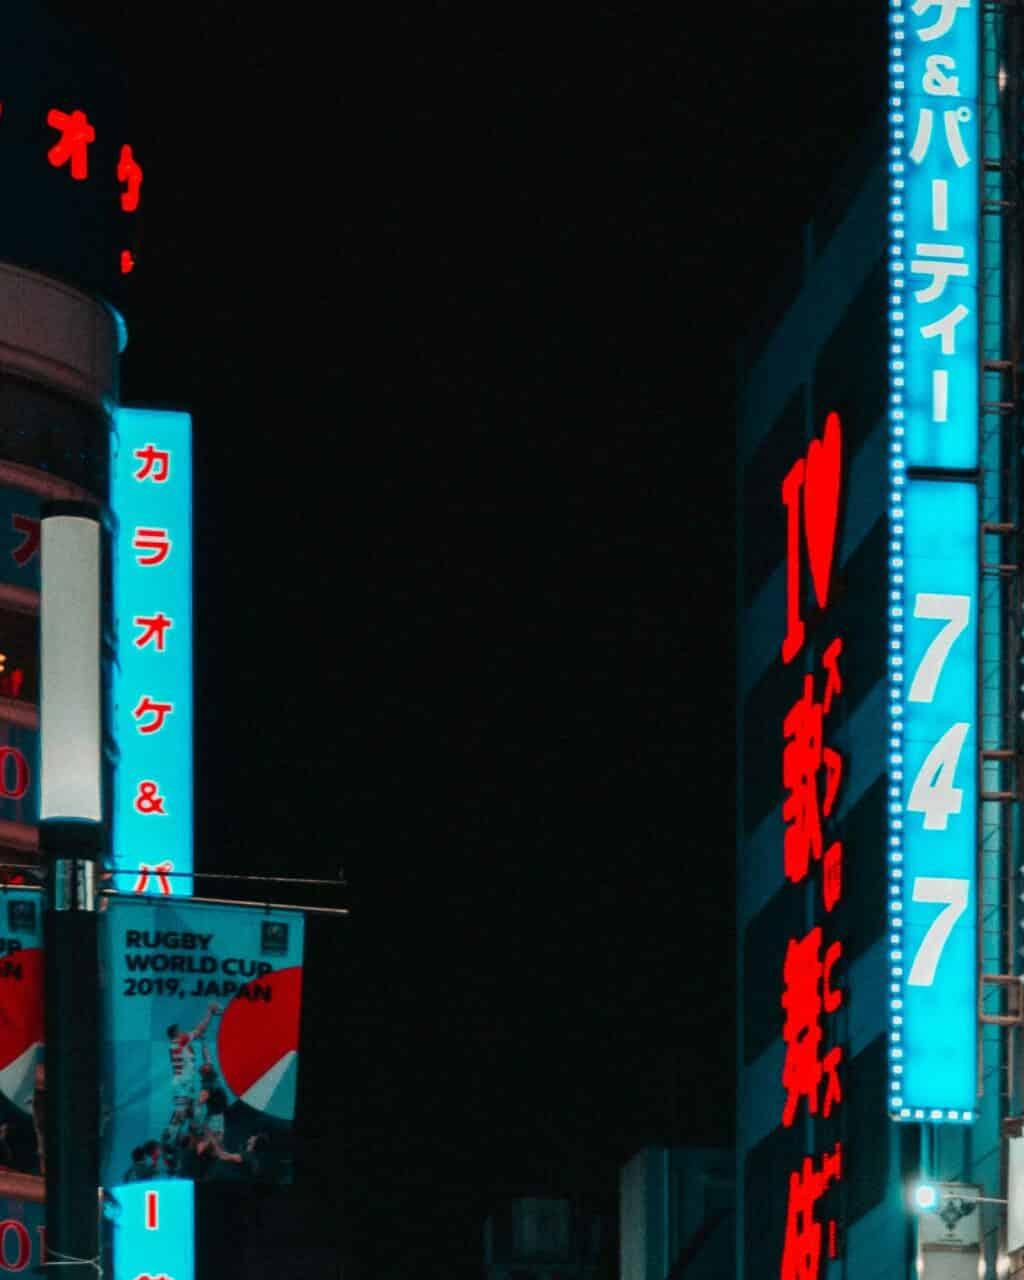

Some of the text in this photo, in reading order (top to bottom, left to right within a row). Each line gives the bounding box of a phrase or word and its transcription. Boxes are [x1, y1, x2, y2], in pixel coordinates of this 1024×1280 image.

[907, 593, 971, 987] 747
[126, 930, 213, 950] RUGBY
[125, 954, 272, 978] WORLD CUP
[124, 978, 272, 1004] 2019, JAPAN
